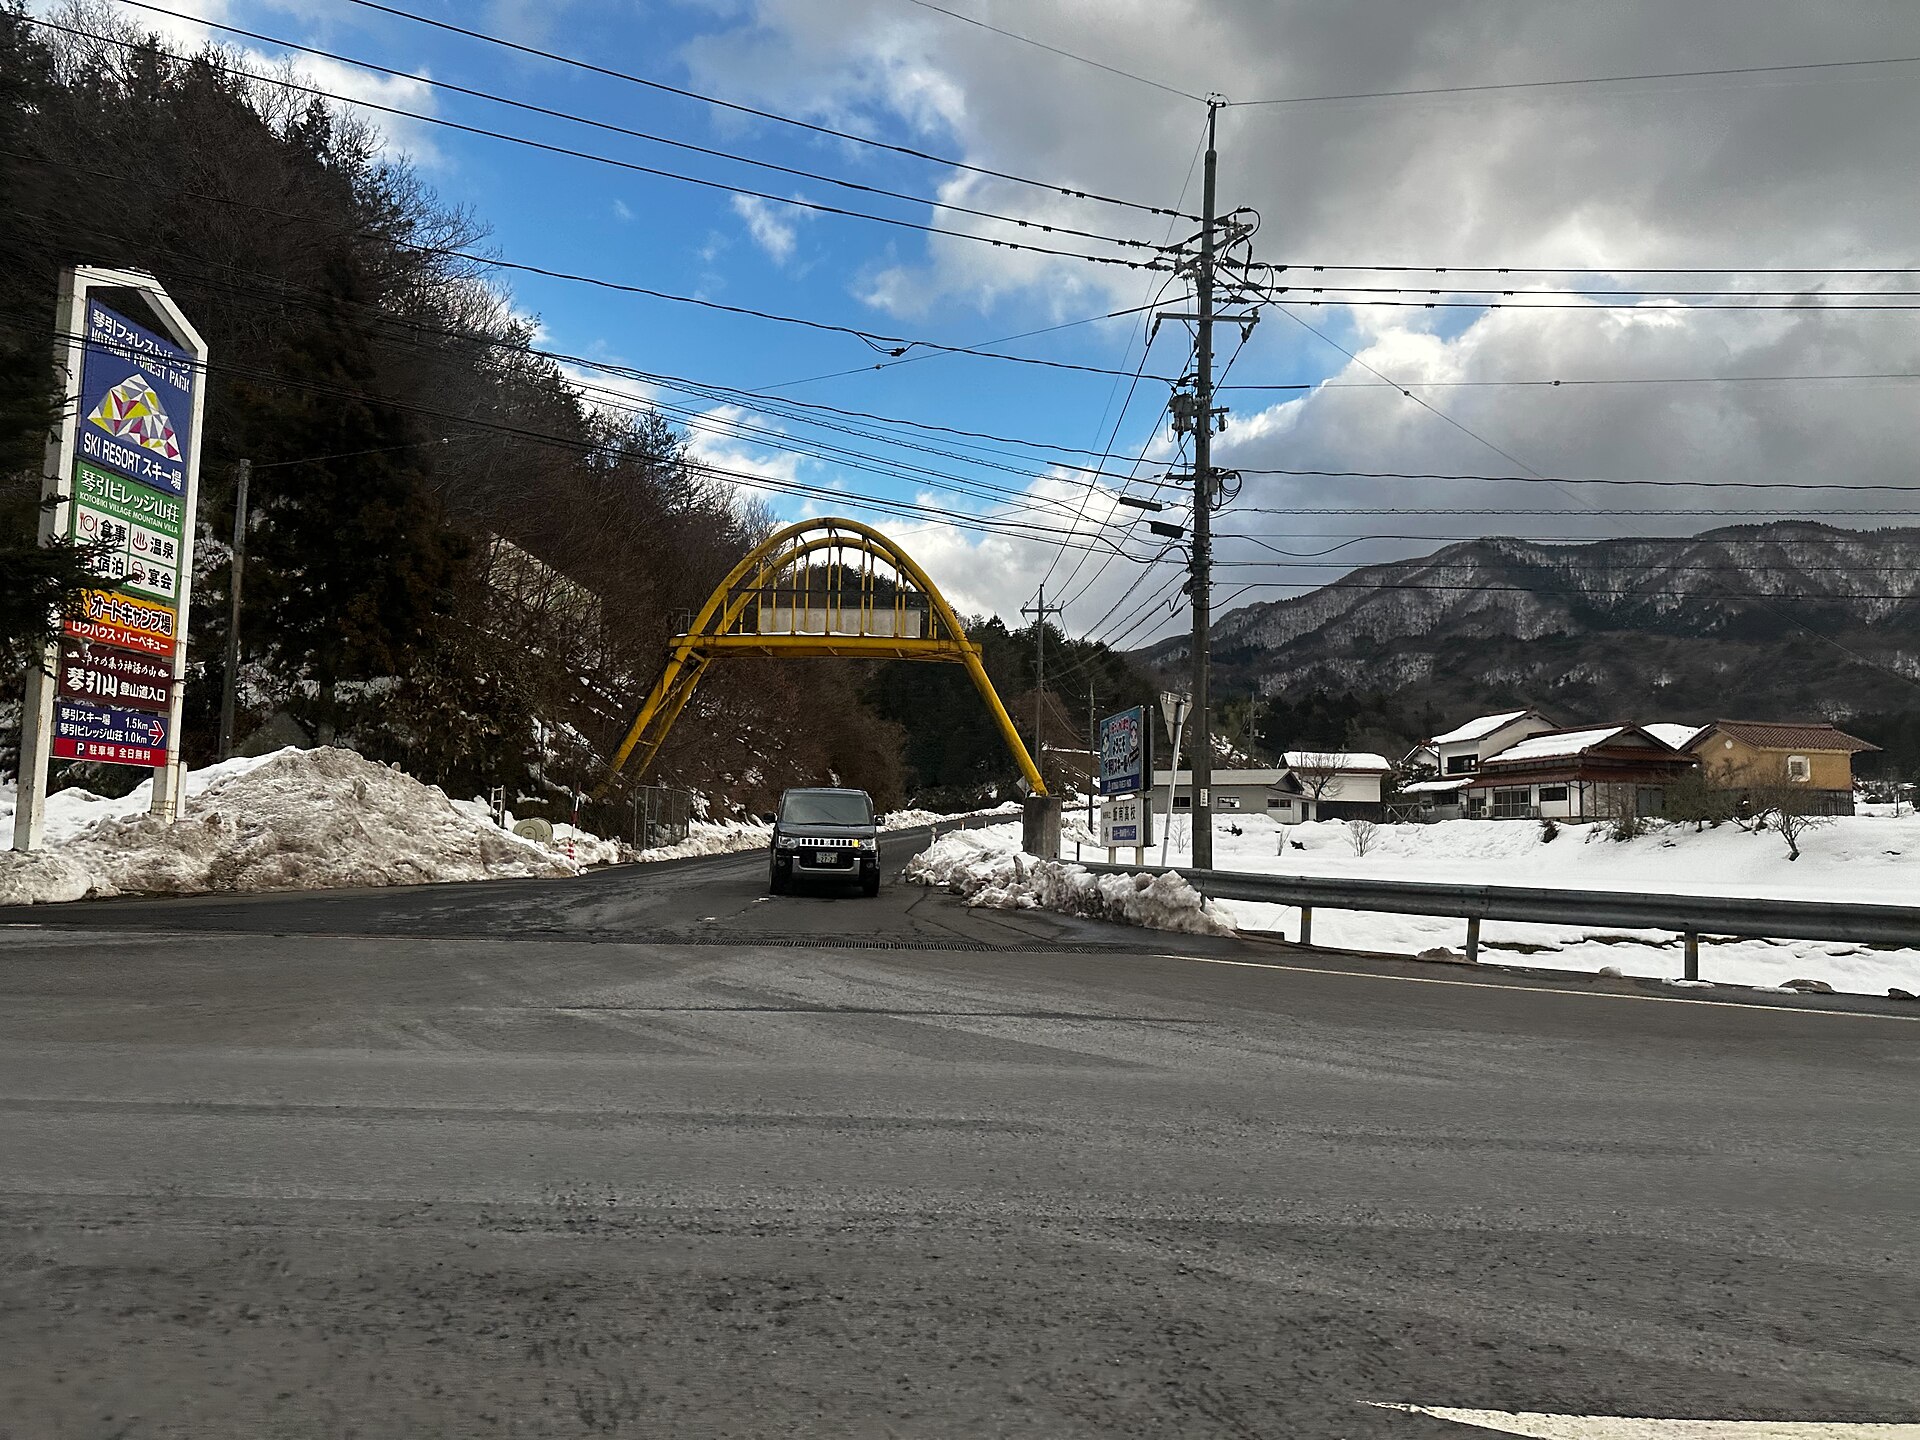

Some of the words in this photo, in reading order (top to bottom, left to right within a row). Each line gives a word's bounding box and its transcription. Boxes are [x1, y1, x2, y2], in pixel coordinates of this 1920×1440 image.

[133, 353, 167, 380] FOREST
[169, 369, 190, 394] PARK
[84, 432, 101, 458] SKI
[102, 439, 141, 474] RESORT
[142, 457, 182, 491] スキー場
[81, 469, 180, 524] 琴引ビレッジ山荘
[79, 491, 108, 508] KOTOBIKI
[108, 500, 132, 517] VILLAGE
[131, 510, 163, 529] MOUNTAIN
[163, 521, 178, 534] VILLA
[100, 519, 127, 543] 食事
[149, 536, 174, 560] 温泉
[98, 553, 124, 577] 宿泊
[147, 567, 173, 591] 宴会
[90, 595, 173, 636] オートキャンプ場
[66, 666, 118, 698] 琴引山
[119, 681, 166, 702] 登山道入口
[61, 707, 111, 726] 琴引スキー場
[125, 716, 149, 731] 1.5km
[60, 722, 123, 742] 琴引ビレッジ山荘
[124, 730, 147, 744] 1.0km
[76, 742, 85, 755] P
[89, 744, 115, 757] 駐車場
[118, 747, 151, 761] 全日無料
